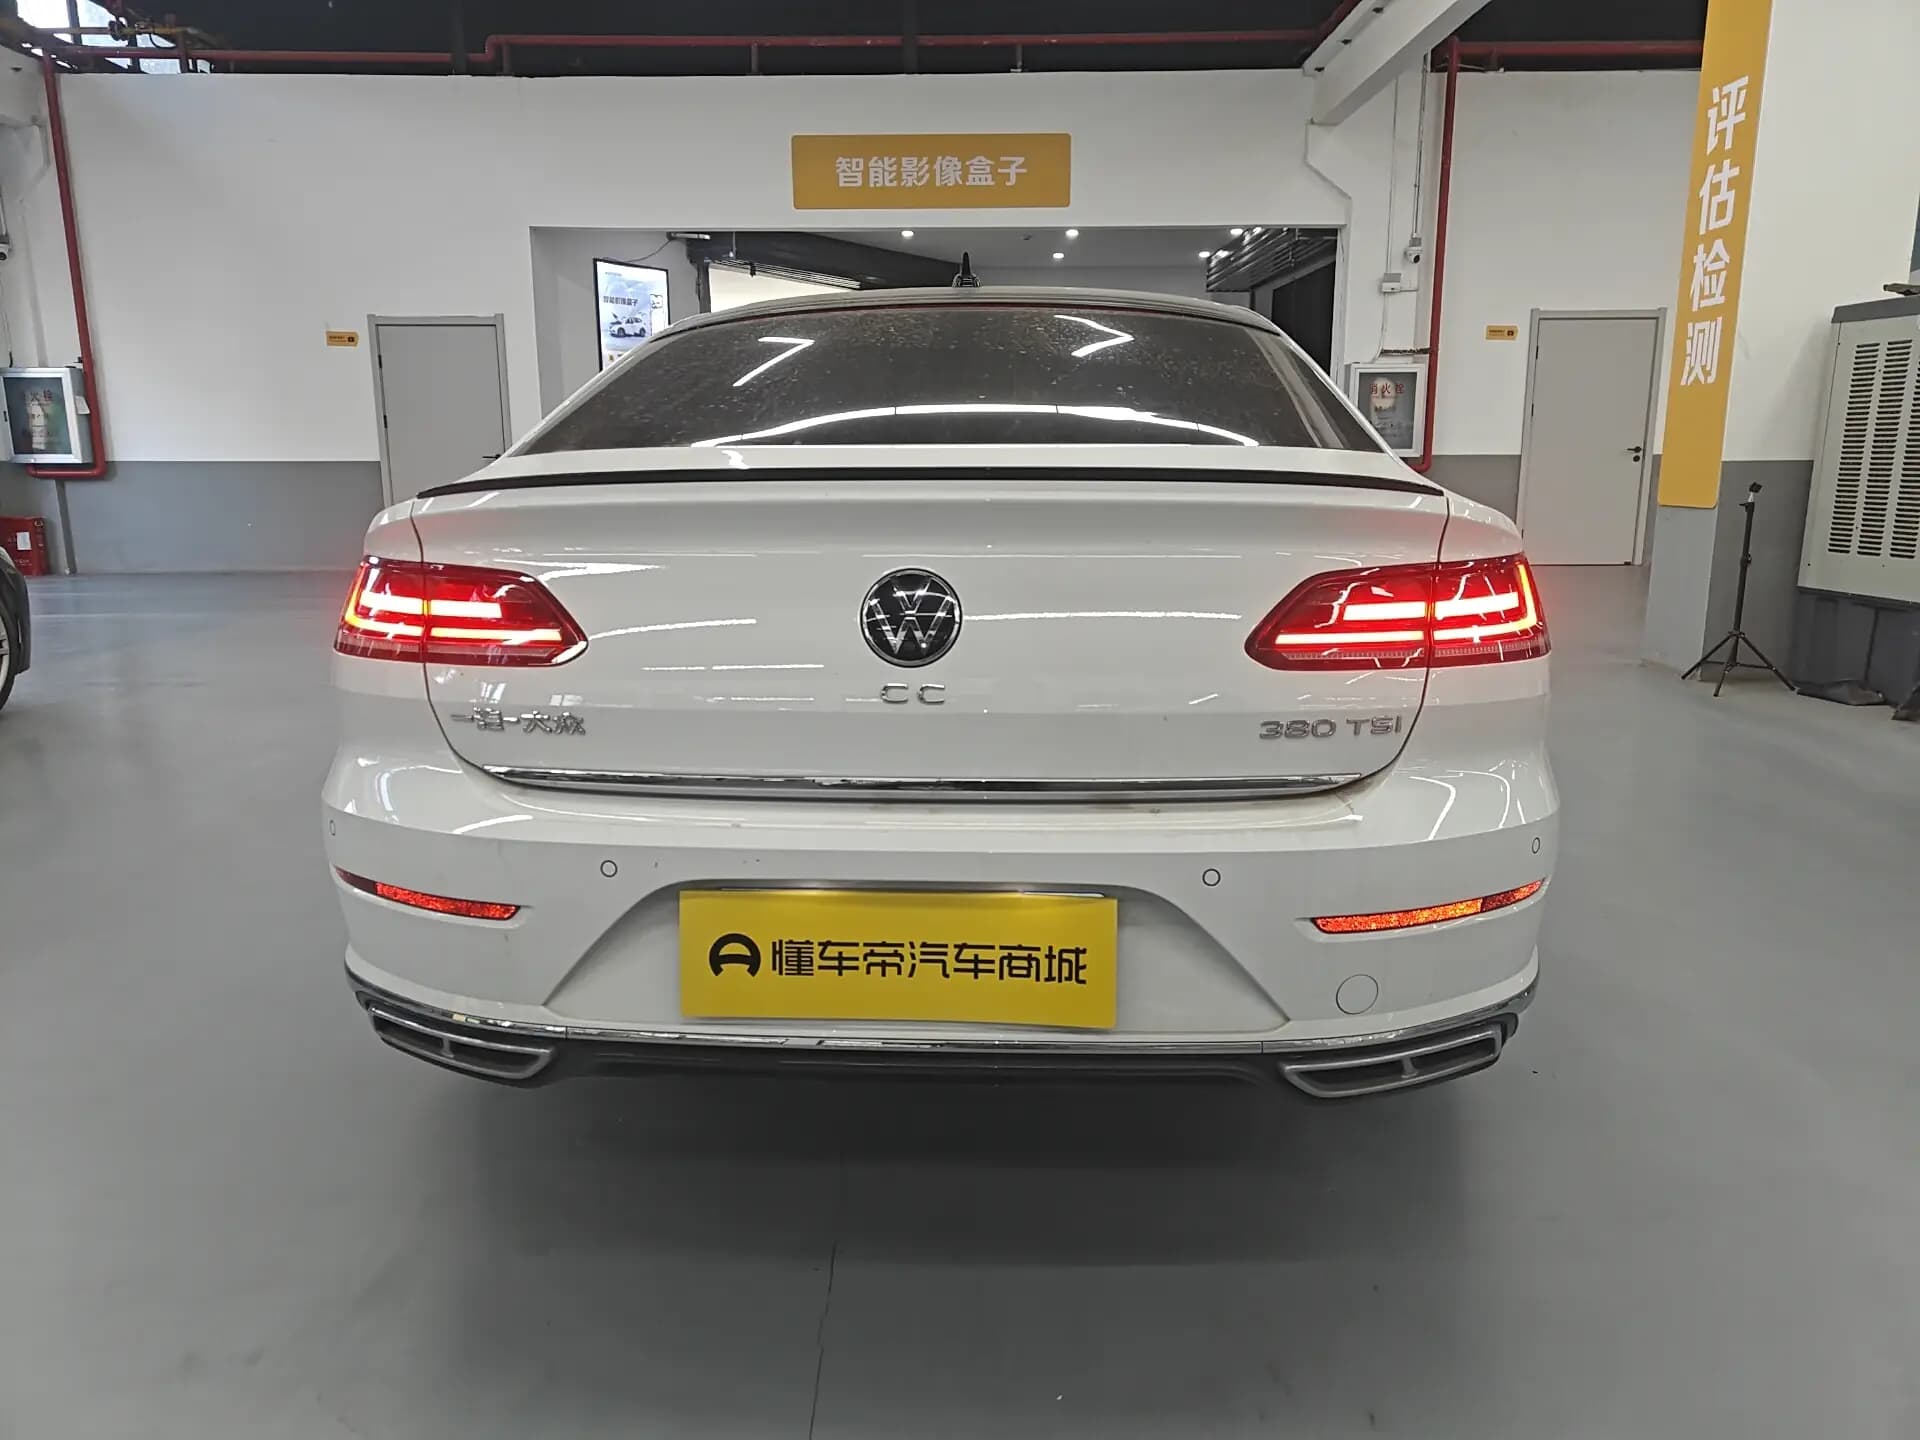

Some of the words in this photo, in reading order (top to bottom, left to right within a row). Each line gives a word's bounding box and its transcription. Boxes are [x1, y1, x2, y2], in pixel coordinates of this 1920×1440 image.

[835, 155, 1028, 188] 智能影像盒子
[1680, 75, 1749, 386] 评估检测
[880, 683, 945, 705] CC
[1259, 719, 1337, 739] 380
[1346, 715, 1403, 737] TSI
[771, 938, 1088, 985] 懂车帝汽车商城
